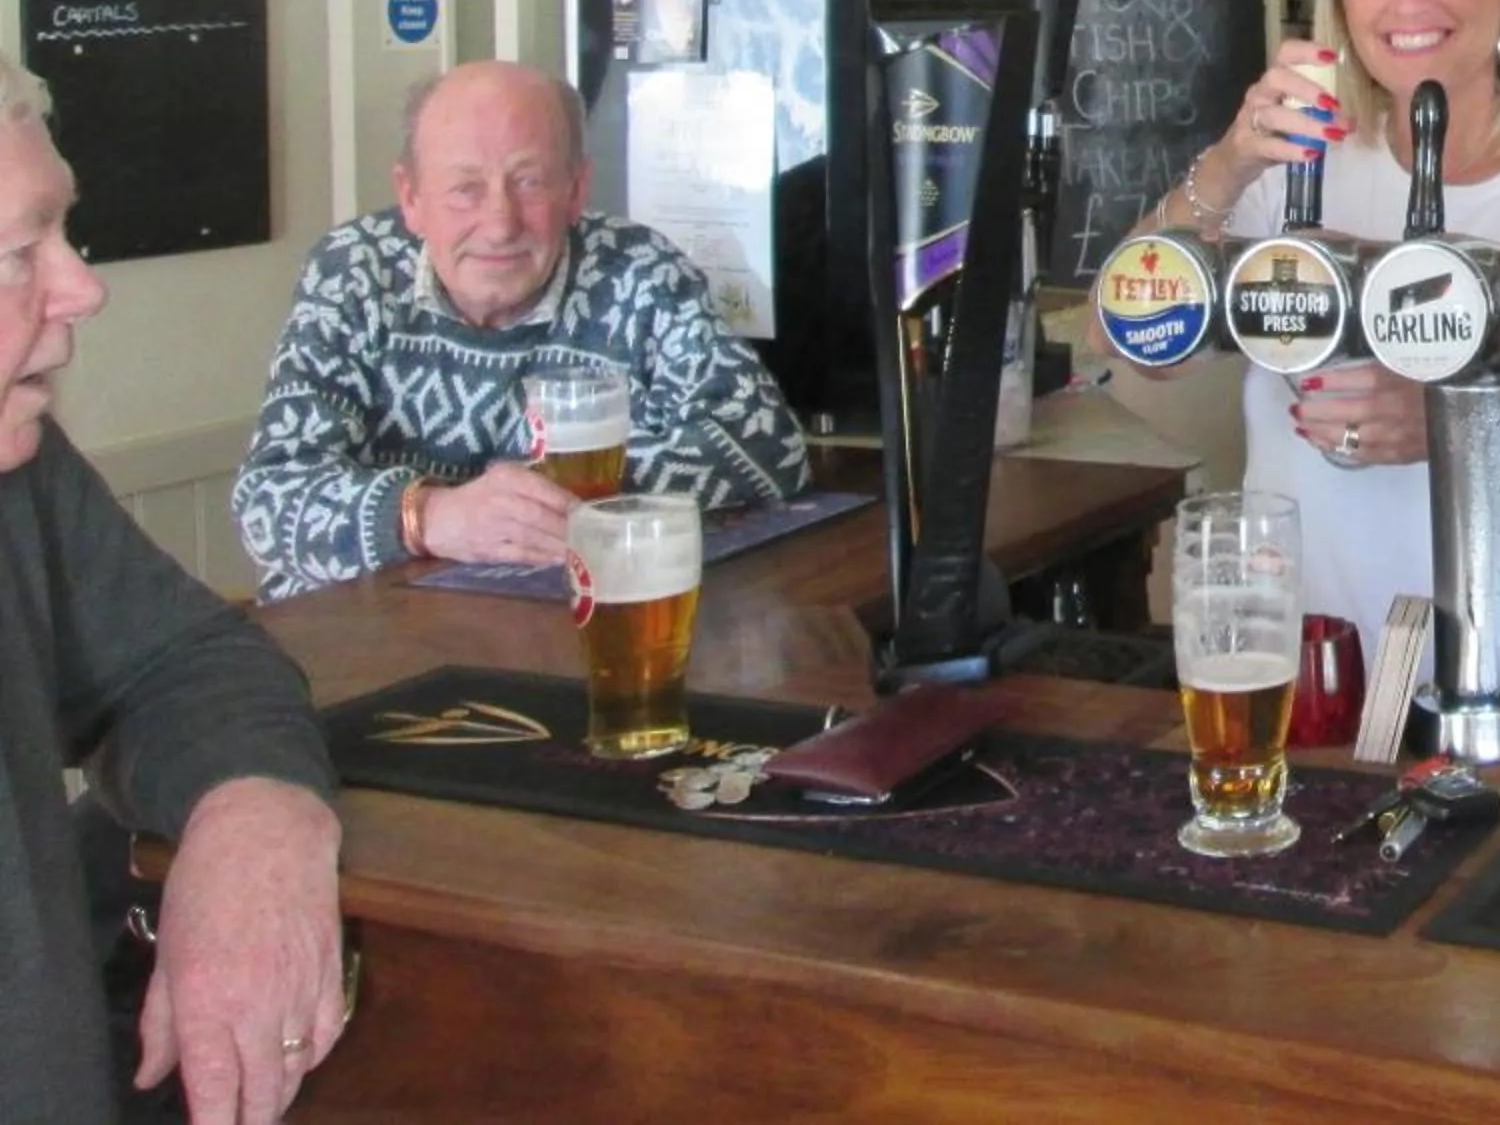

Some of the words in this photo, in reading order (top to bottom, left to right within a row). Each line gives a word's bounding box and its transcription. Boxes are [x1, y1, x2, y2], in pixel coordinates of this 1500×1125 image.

[1070, 24, 1156, 64] FISH
[1072, 68, 1198, 126] CHIPS
[892, 120, 977, 144] STRONGBOW
[1239, 290, 1330, 317] STOWFORD
[1125, 321, 1185, 345] SMOOTH
[1263, 315, 1307, 333] PRESS
[1372, 310, 1474, 344] CARLING
